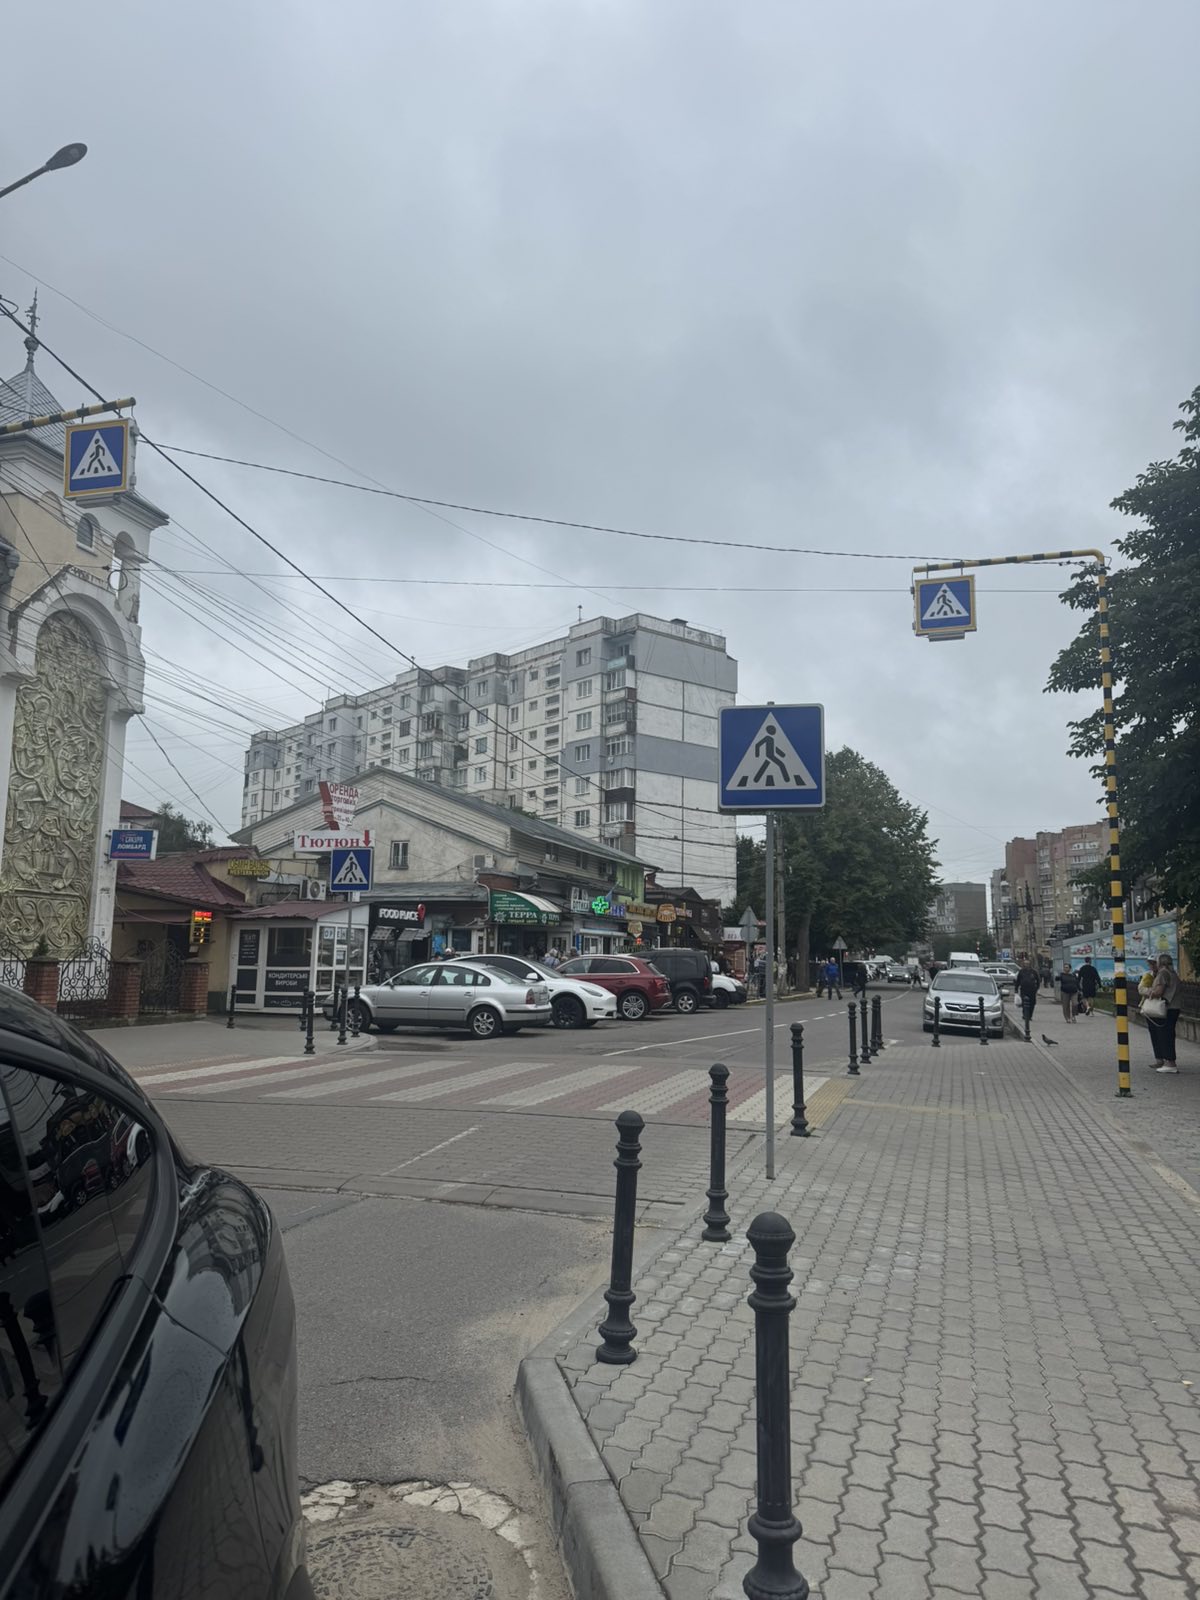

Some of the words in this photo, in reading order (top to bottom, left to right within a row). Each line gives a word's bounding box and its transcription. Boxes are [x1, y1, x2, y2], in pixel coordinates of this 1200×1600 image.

[329, 783, 359, 799] ОРЕНДА
[117, 843, 147, 851] ЛОМБАРД
[379, 908, 399, 919] FOOD
[400, 910, 419, 920] PLACE
[508, 911, 537, 919] ТЕРРА
